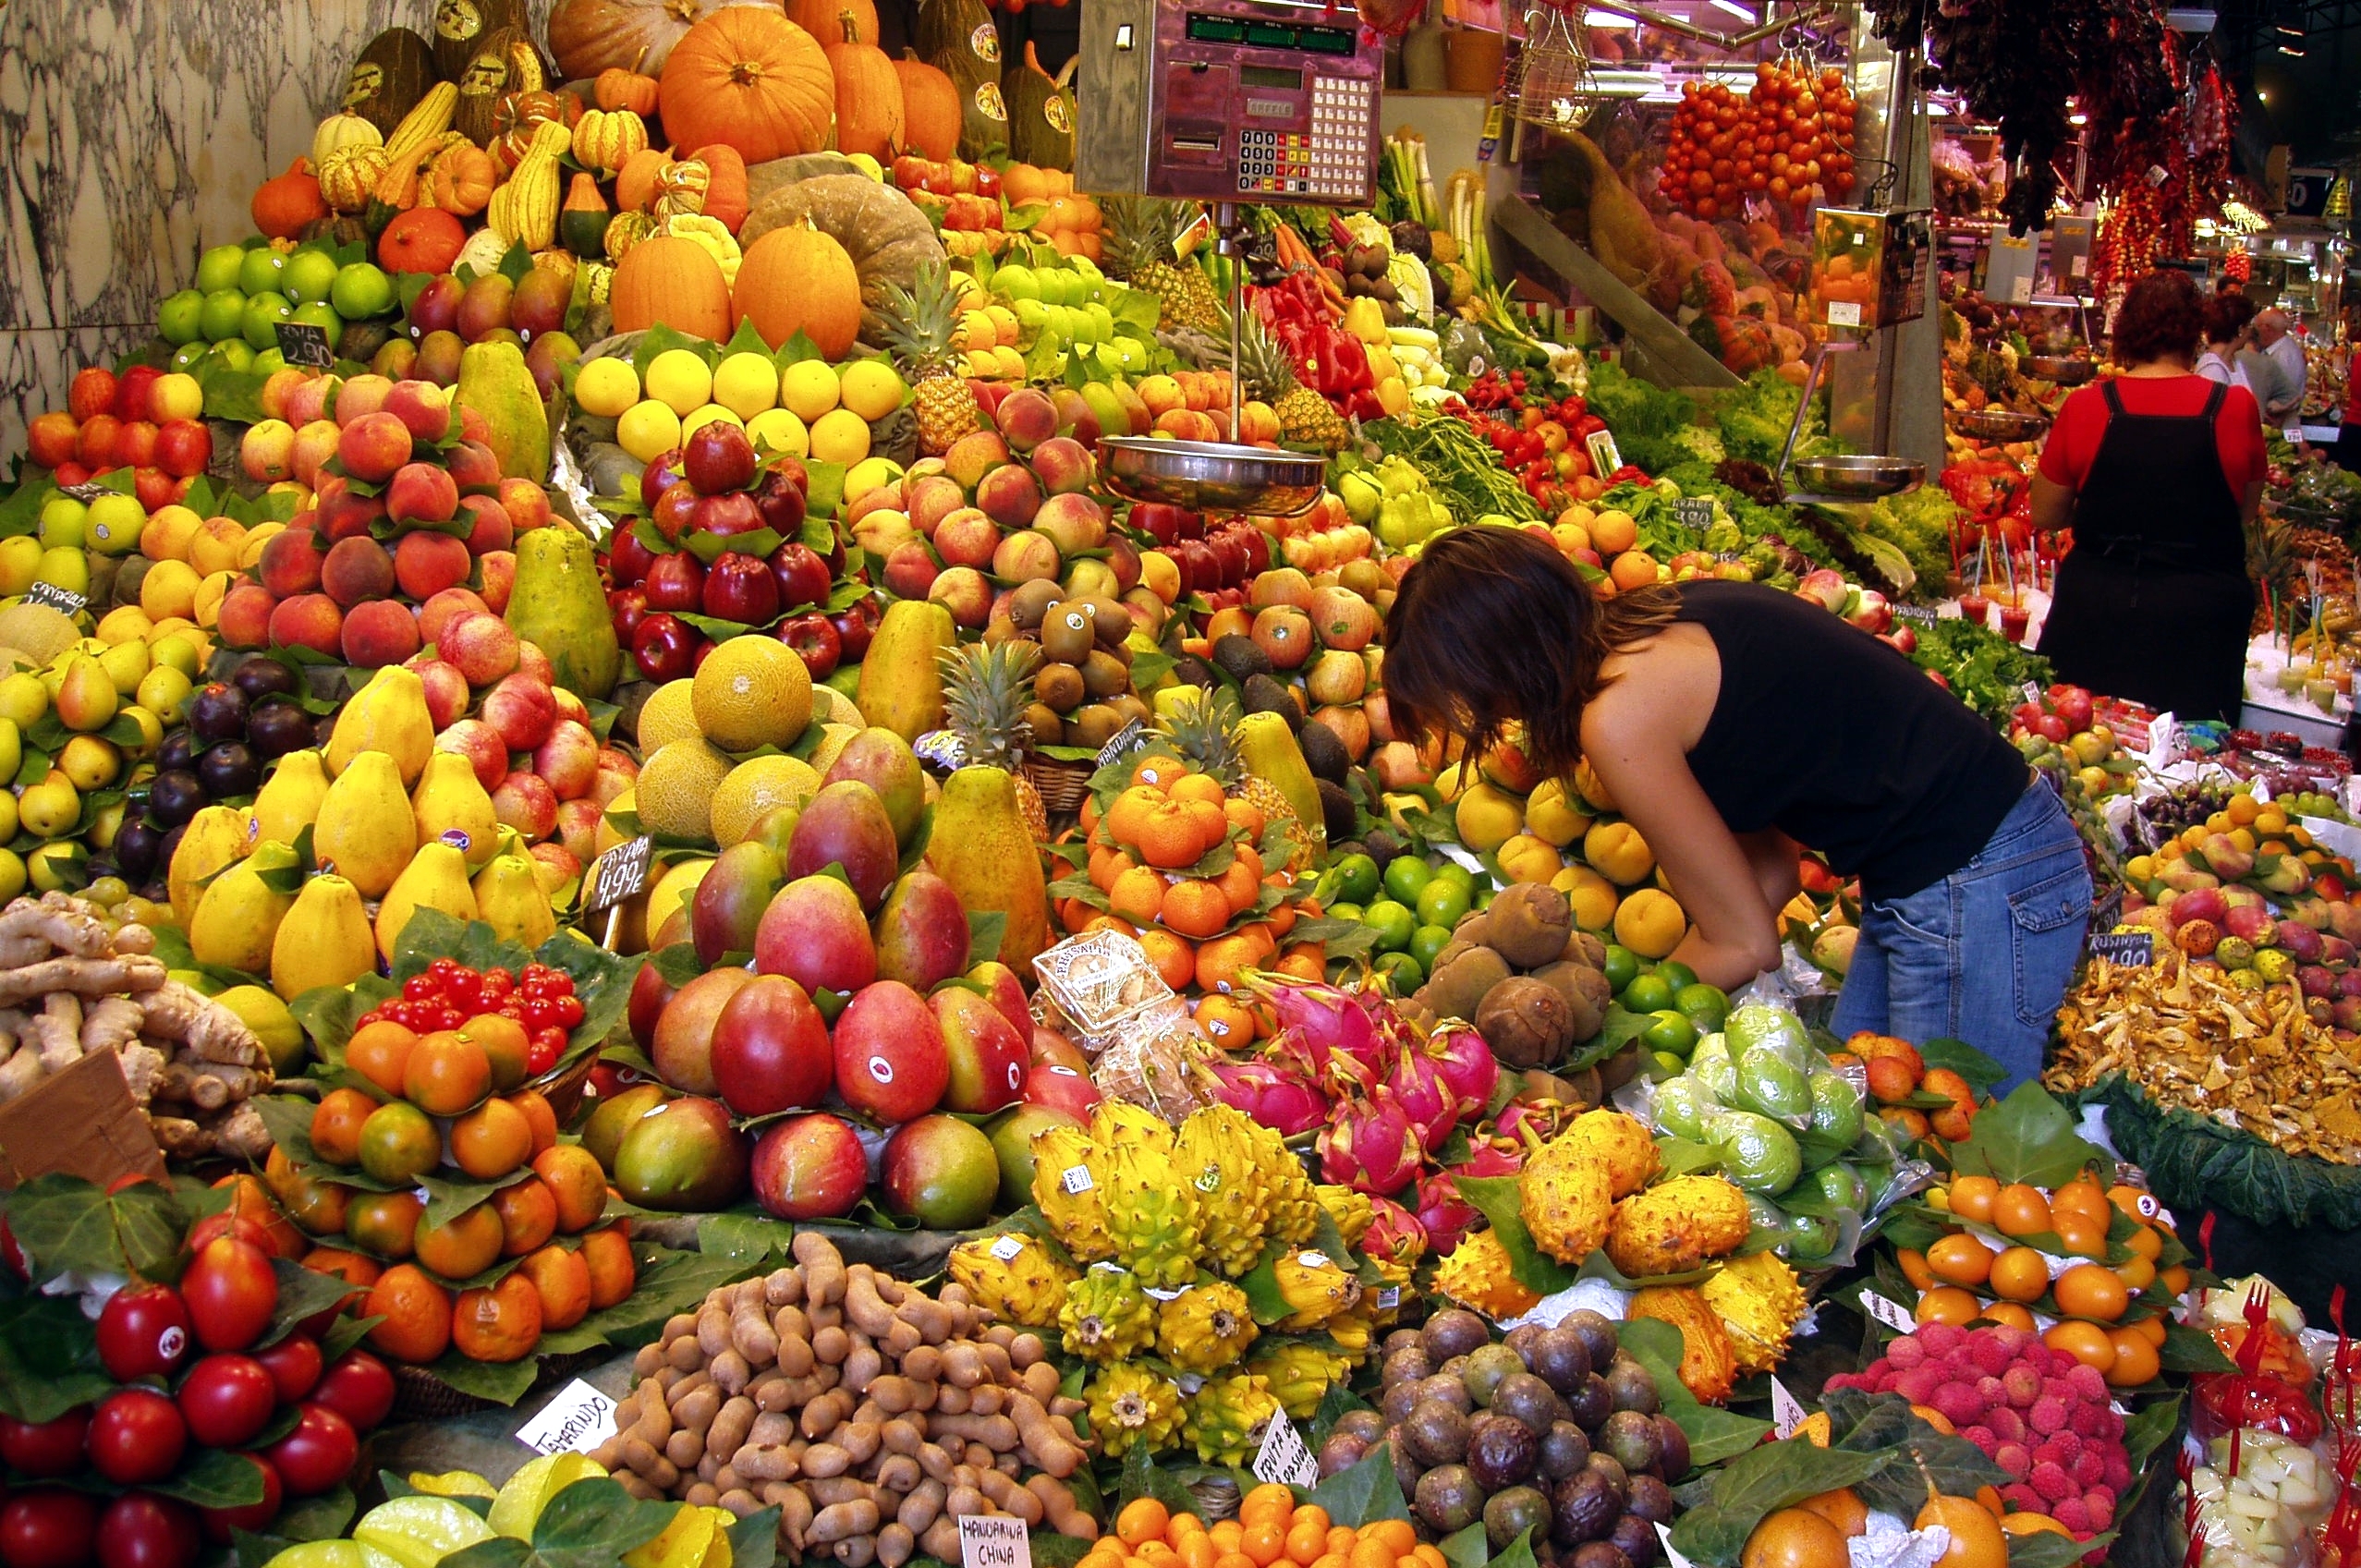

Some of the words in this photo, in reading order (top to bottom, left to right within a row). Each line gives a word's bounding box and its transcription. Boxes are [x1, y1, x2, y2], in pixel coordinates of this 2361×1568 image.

[1260, 1430, 1284, 1484] FRUTA
[962, 1520, 1023, 1541] MANDARINA
[978, 1541, 1015, 1566] CHINA
